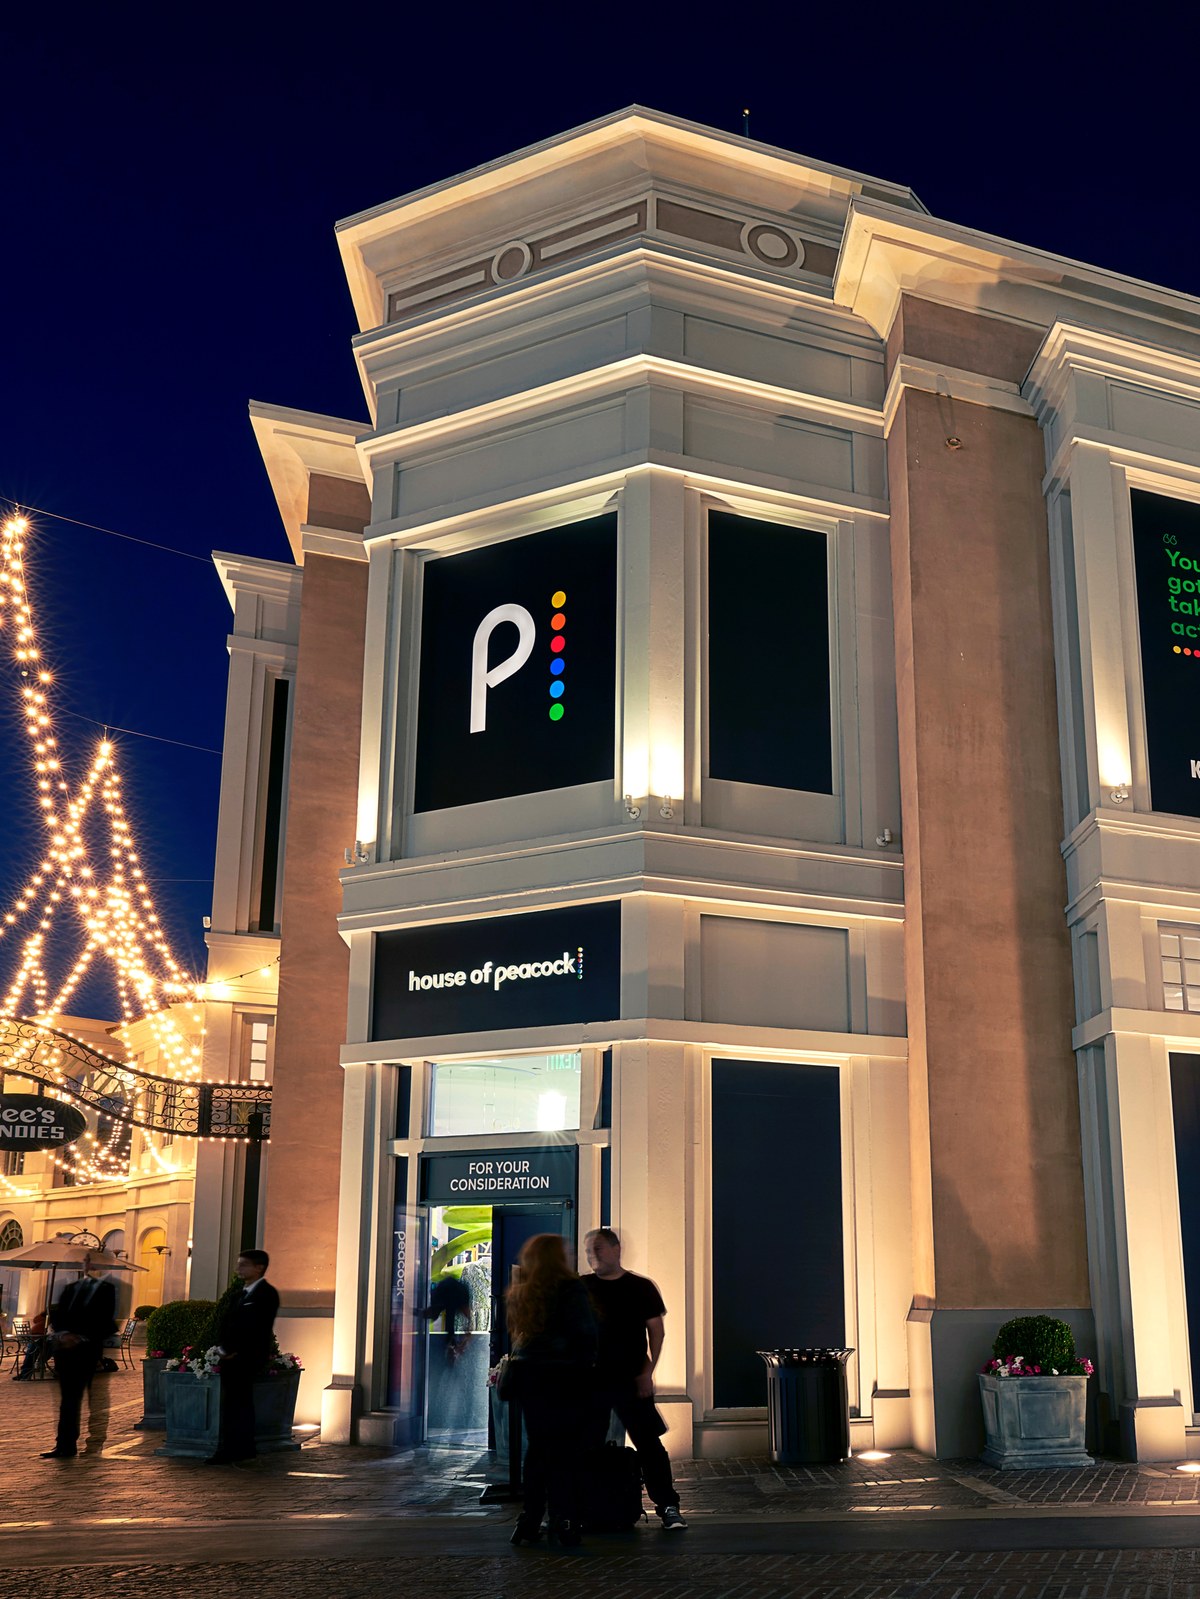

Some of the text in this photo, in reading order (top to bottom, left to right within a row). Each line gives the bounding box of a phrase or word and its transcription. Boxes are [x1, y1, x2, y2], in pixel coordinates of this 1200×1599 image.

[408, 952, 576, 992] house of peacock
[0, 1104, 55, 1123] ee's
[0, 1125, 64, 1139] NDIES
[469, 1161, 530, 1175] FOR YOUR
[450, 1176, 550, 1191] CONSIDERATION
[394, 1231, 406, 1296] peacock
